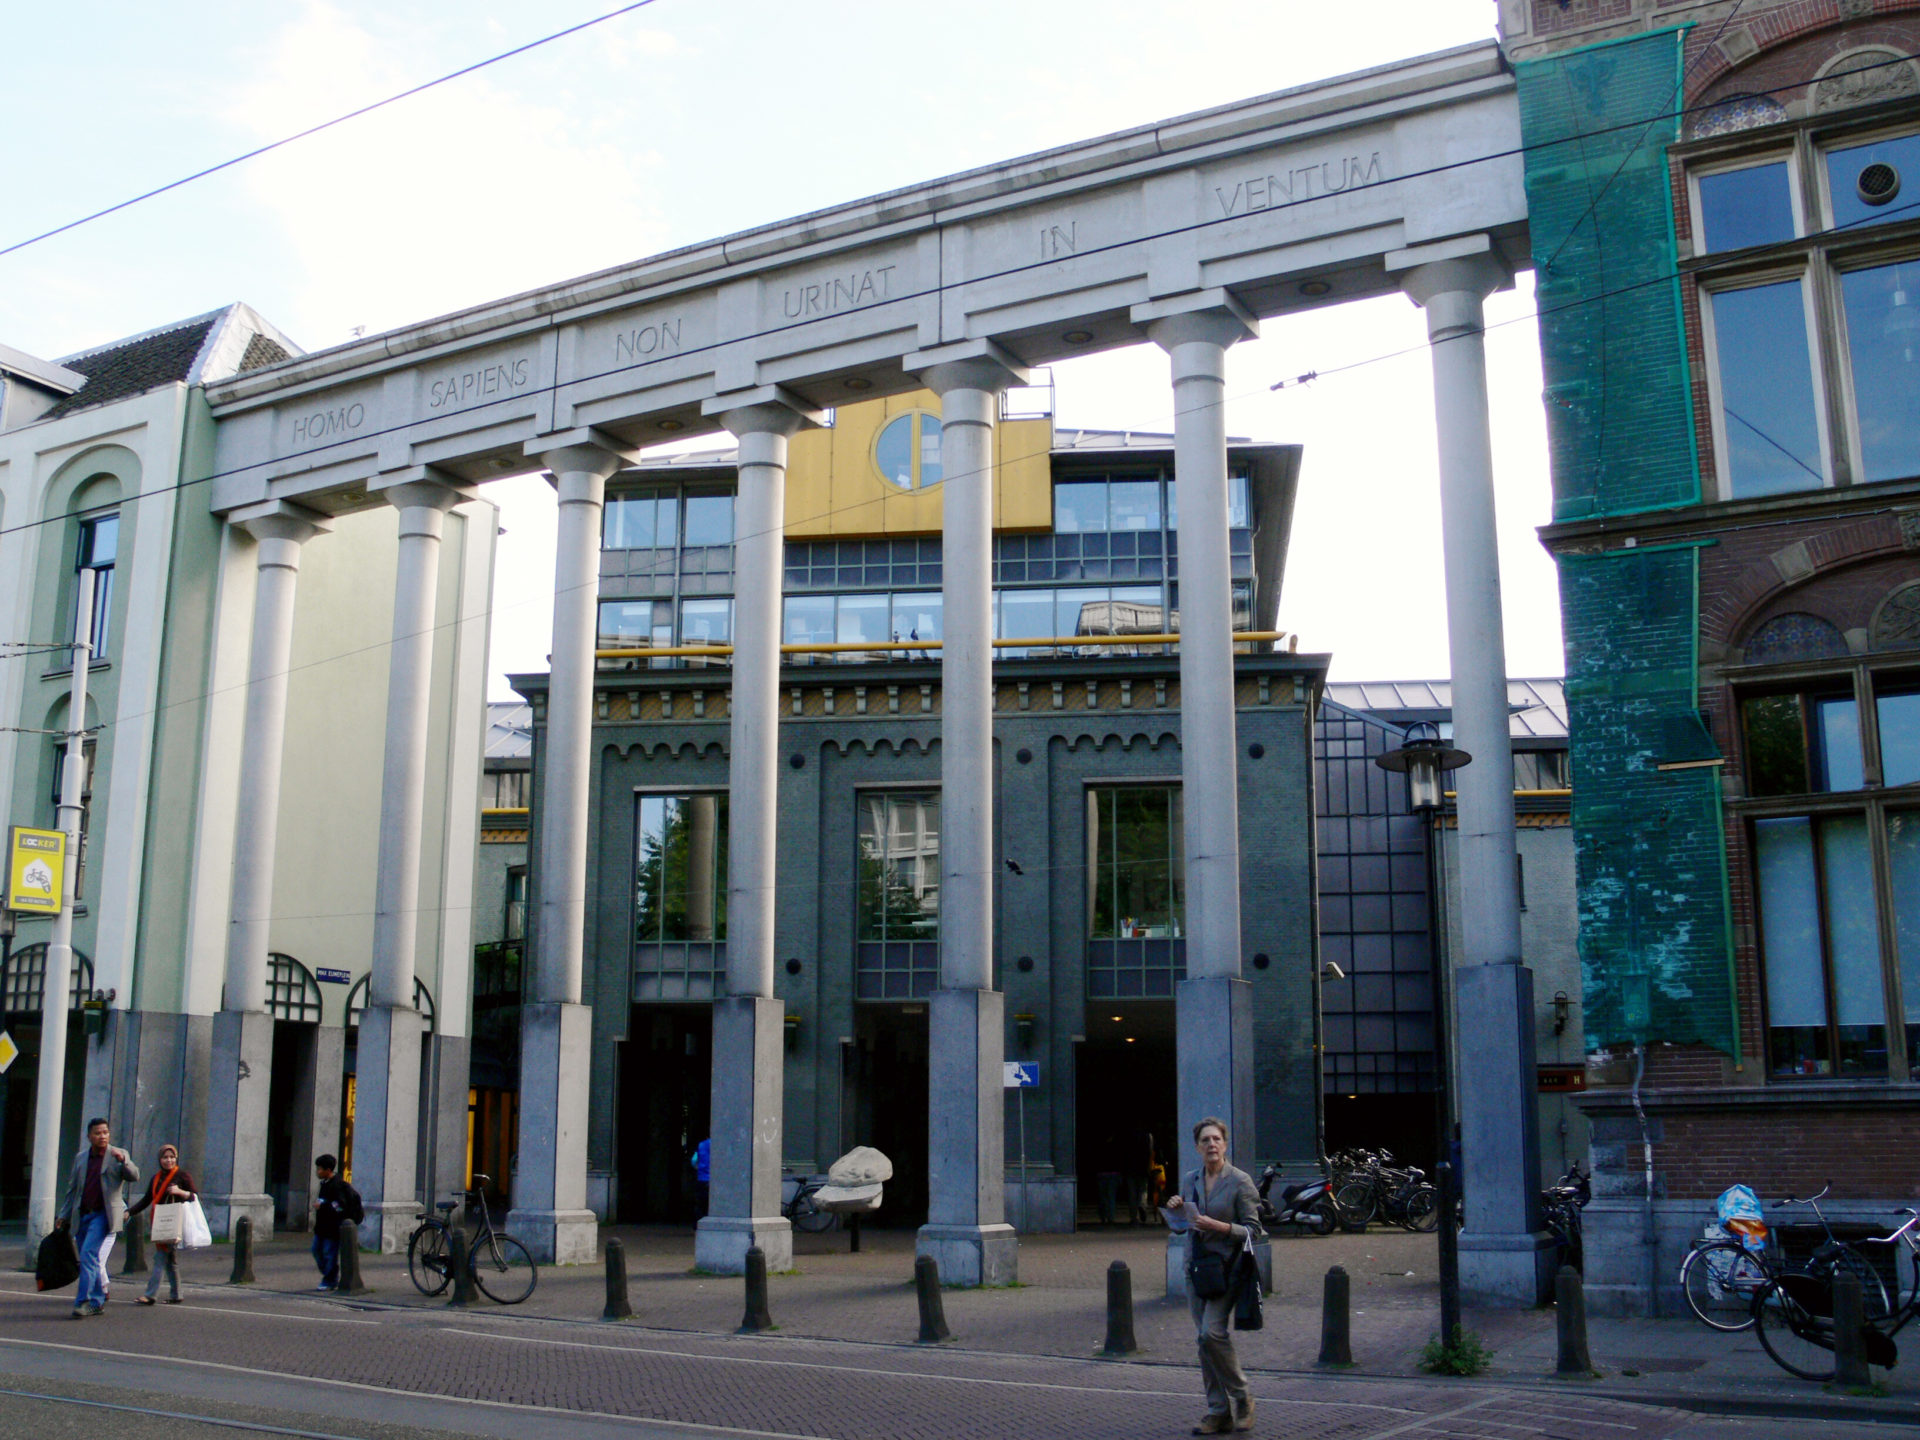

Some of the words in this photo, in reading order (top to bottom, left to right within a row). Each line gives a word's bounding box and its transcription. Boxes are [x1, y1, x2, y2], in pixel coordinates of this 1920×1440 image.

[293, 403, 364, 443] HOMO
[430, 359, 528, 407] SAPIENS
[616, 319, 681, 361] NON
[784, 265, 896, 318] URINAT
[1041, 221, 1076, 259] IN
[1216, 152, 1383, 217] VENTUM
[22, 838, 55, 849] LOCKER
